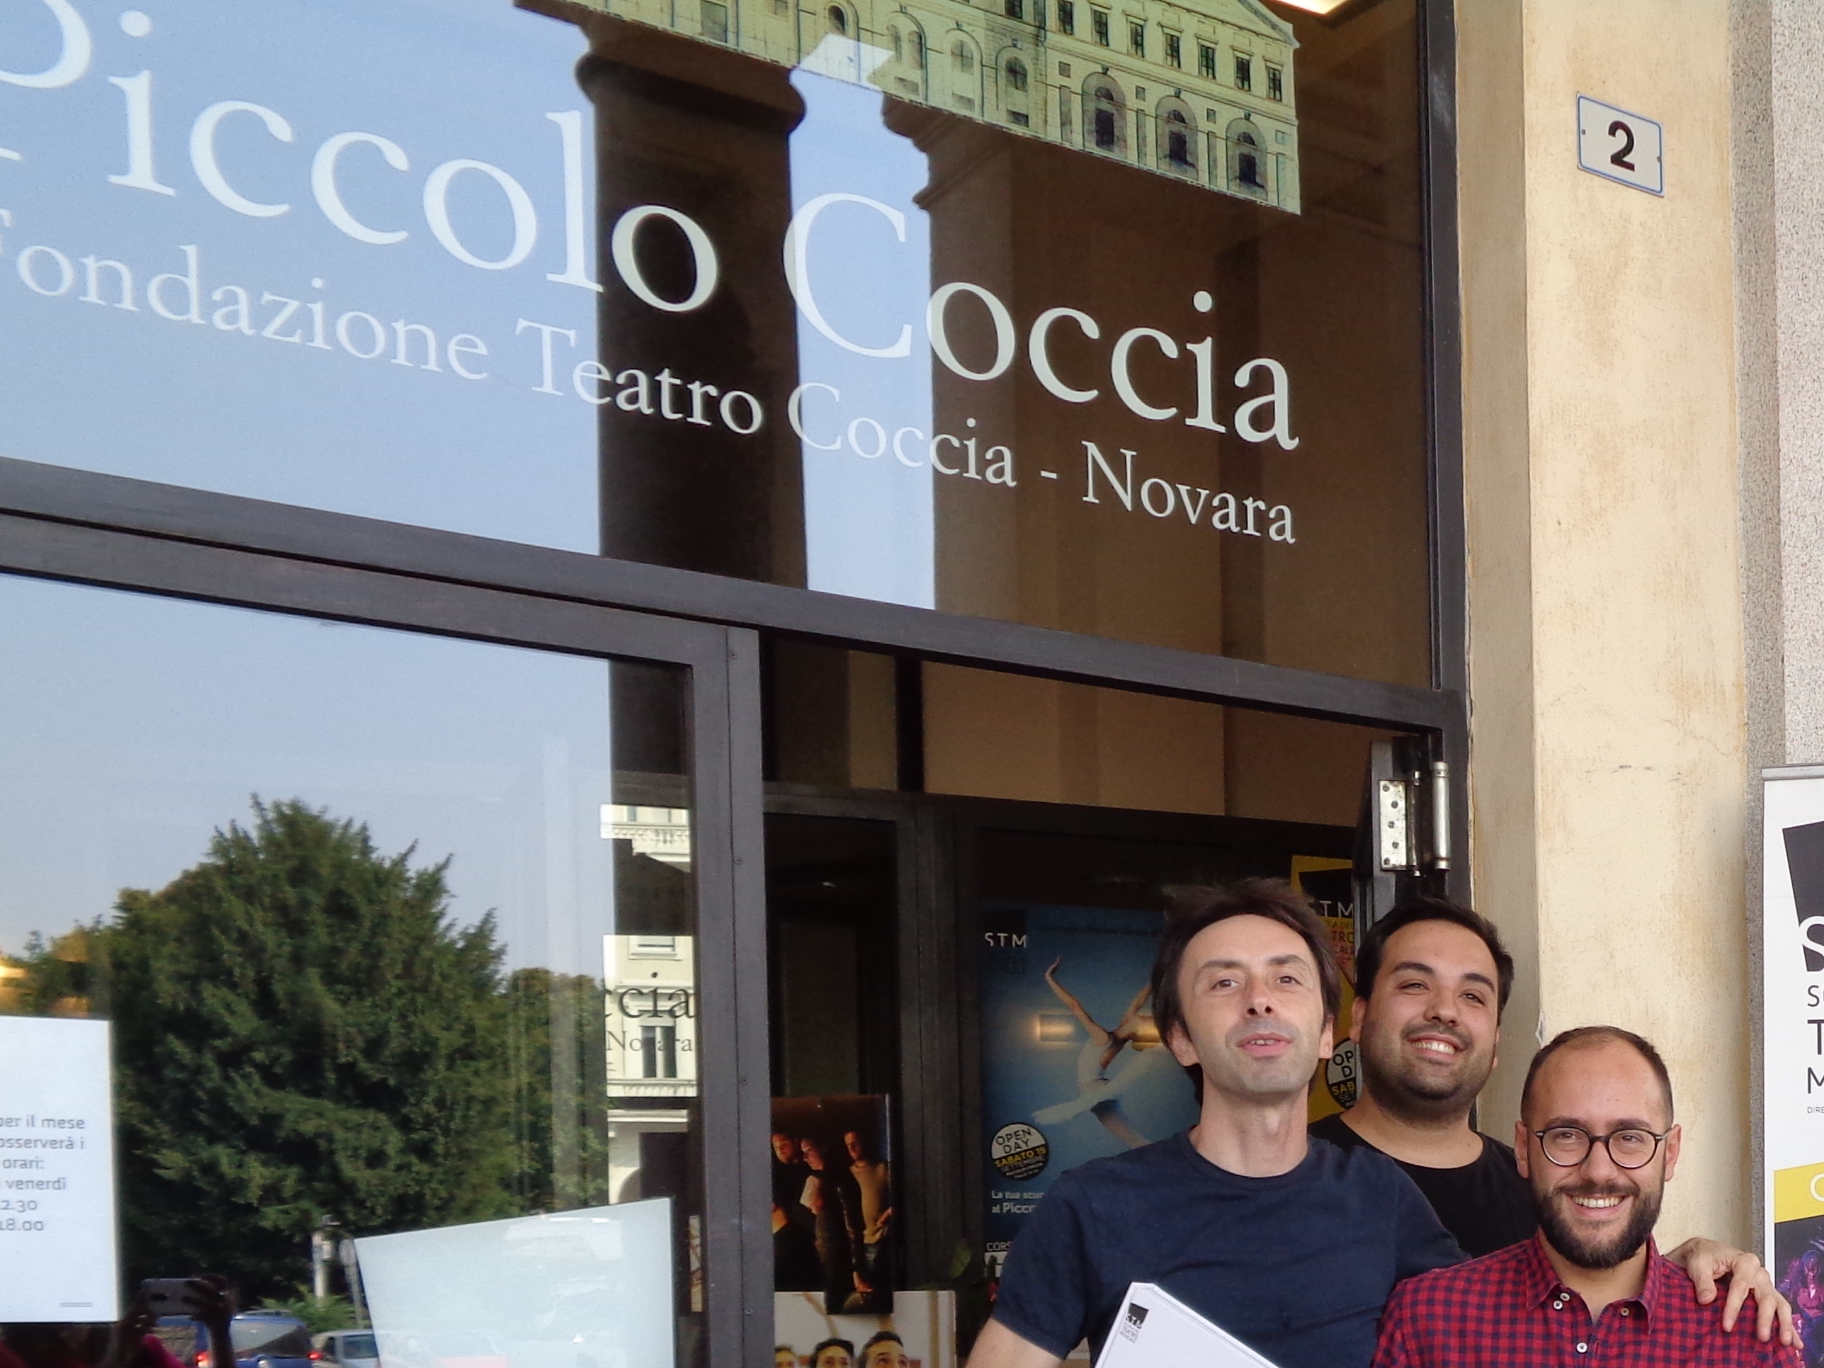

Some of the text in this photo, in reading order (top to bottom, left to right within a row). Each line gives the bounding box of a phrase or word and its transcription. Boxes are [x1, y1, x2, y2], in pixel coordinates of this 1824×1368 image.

[1608, 120, 1635, 172] 2
[783, 192, 1300, 450] Coccia
[0, 208, 1297, 545] ondazione Teatro Coccia Novara
[1319, 900, 1354, 919] TM
[985, 932, 1028, 948] STM
[26, 1115, 35, 1128] il
[41, 1118, 85, 1130] mese
[996, 1128, 1032, 1145] OPEN
[1003, 1139, 1030, 1154] DAY
[995, 1150, 1034, 1168] SABATO
